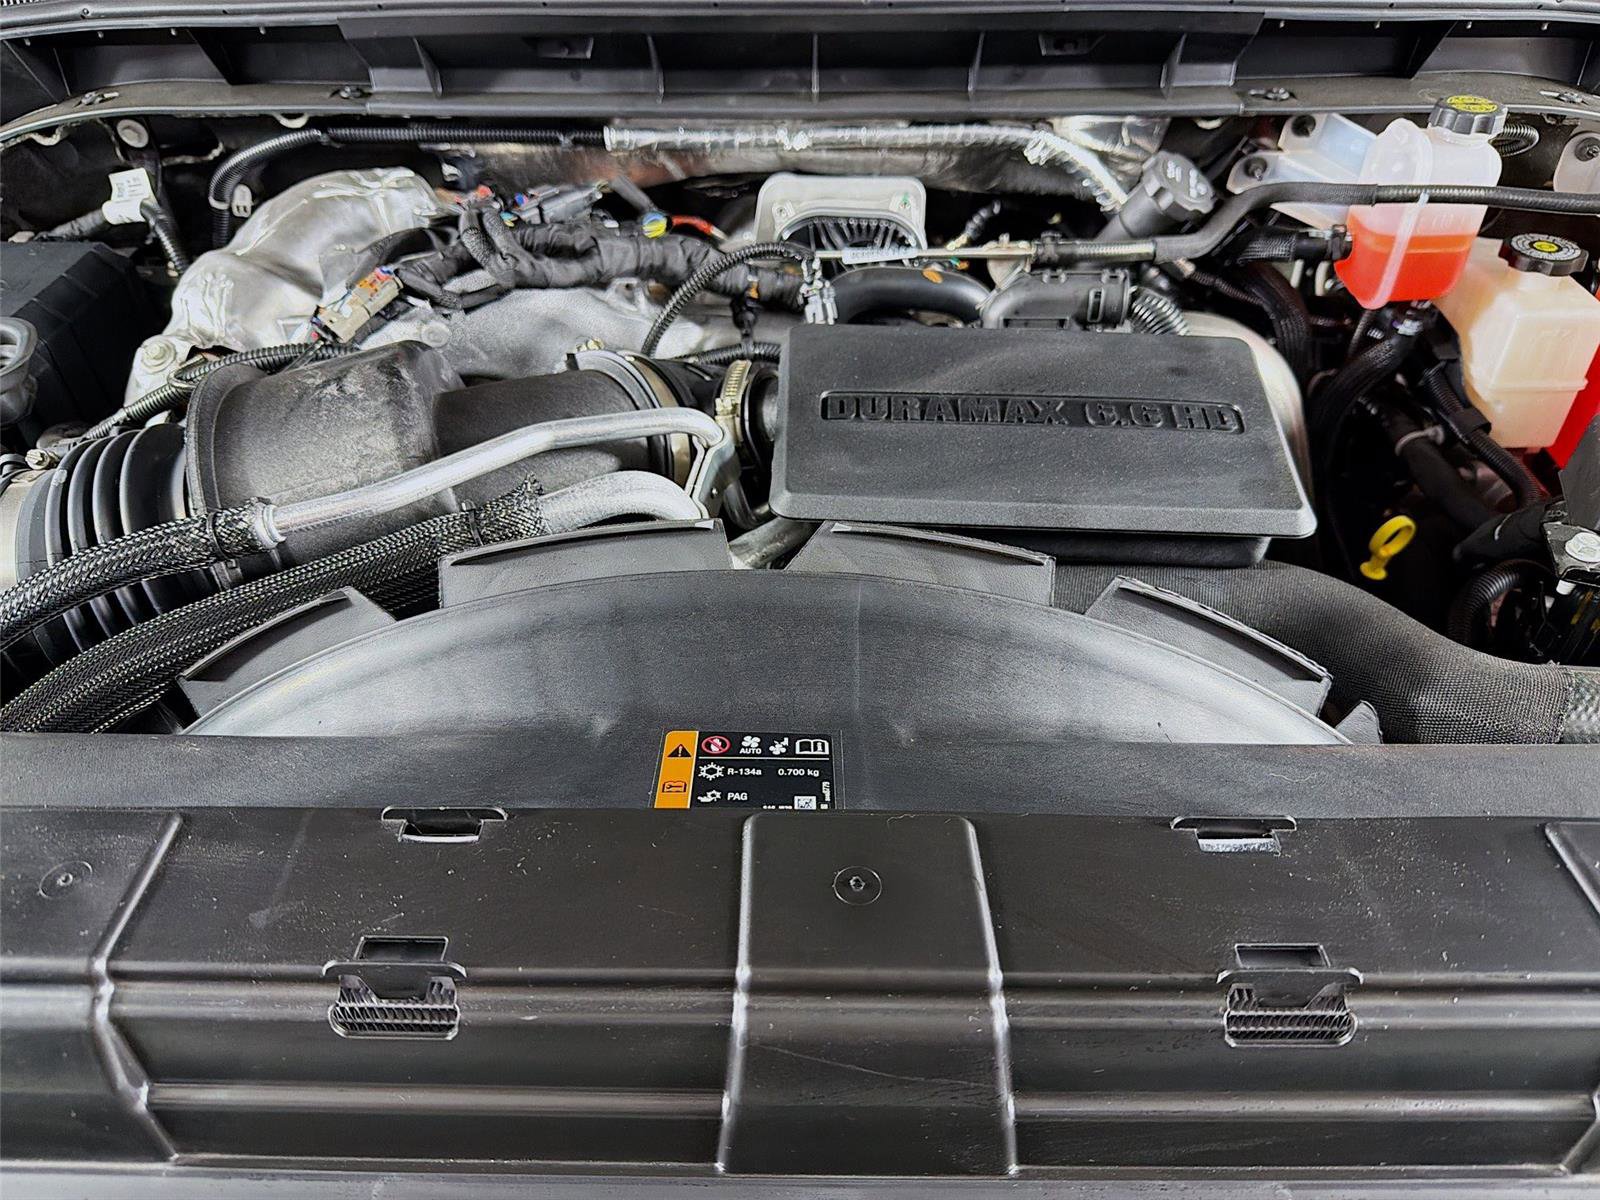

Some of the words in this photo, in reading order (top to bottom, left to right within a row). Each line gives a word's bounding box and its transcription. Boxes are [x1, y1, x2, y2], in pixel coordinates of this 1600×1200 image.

[827, 394, 1070, 426] DURAMAX
[1085, 401, 1164, 428] 6.6
[1171, 404, 1240, 433] HD
[739, 747, 762, 755] AUTO
[727, 768, 762, 776] R-134a
[778, 768, 805, 776] 0.700
[807, 768, 820, 777] kg
[727, 792, 748, 801] PAG
